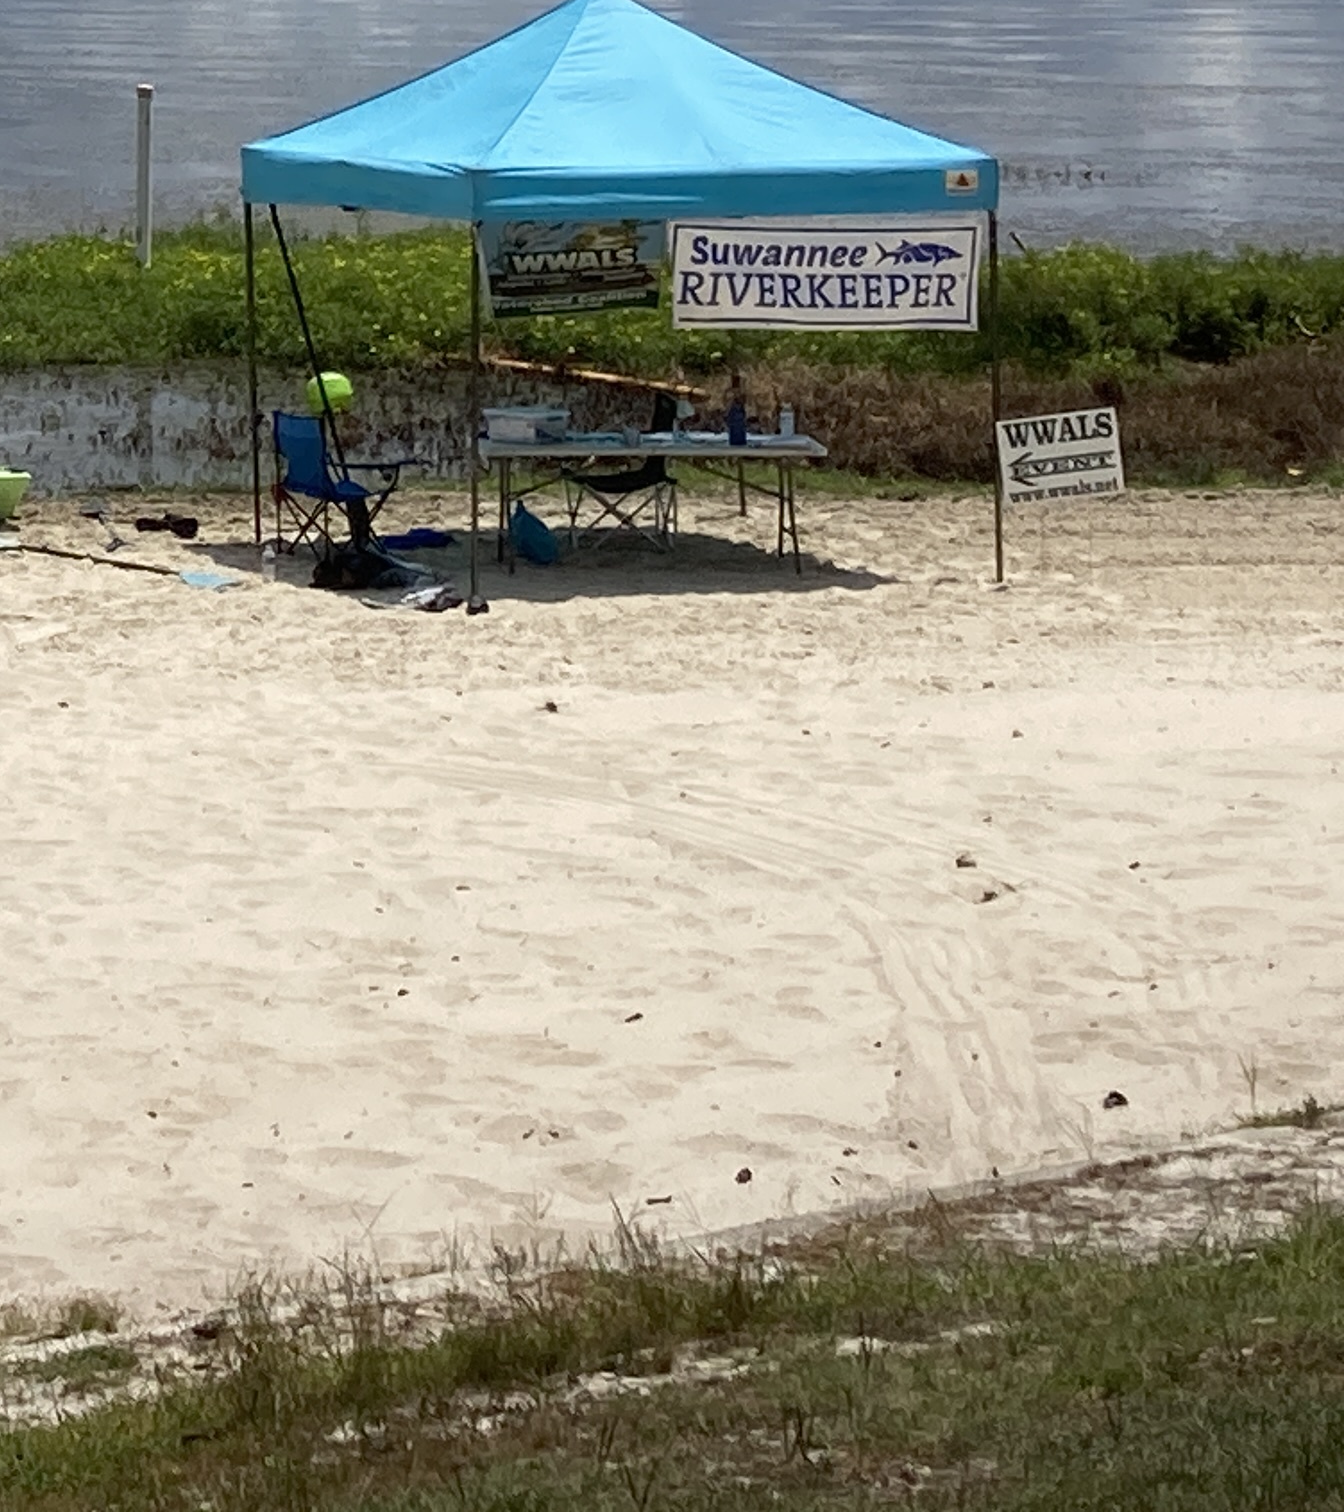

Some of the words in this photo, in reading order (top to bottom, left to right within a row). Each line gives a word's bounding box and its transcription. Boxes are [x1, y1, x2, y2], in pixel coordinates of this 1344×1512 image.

[512, 247, 636, 274] WWALS
[690, 235, 868, 268] Suwannee
[1001, 412, 1114, 449] WWALS
[1012, 453, 1115, 478] EVENT
